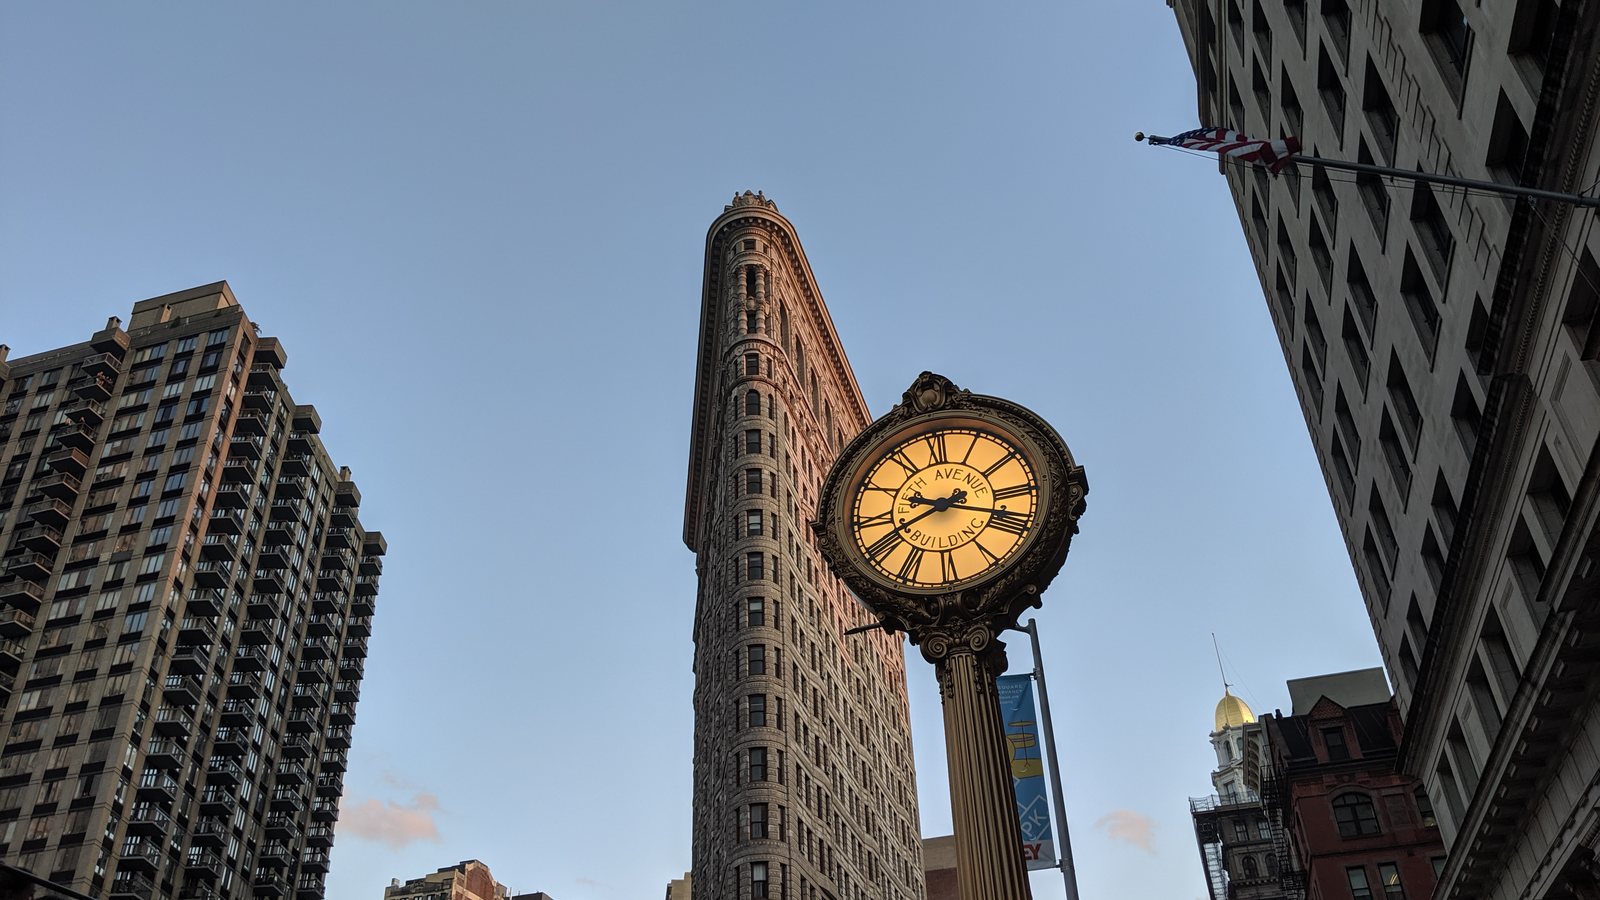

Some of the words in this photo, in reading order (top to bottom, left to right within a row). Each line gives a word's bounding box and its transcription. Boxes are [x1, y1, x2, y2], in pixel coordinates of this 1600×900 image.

[898, 477, 927, 514] FIFTH
[935, 468, 988, 498] AVENUE
[909, 517, 984, 548] BUILDING
[1020, 808, 1047, 837] PK
